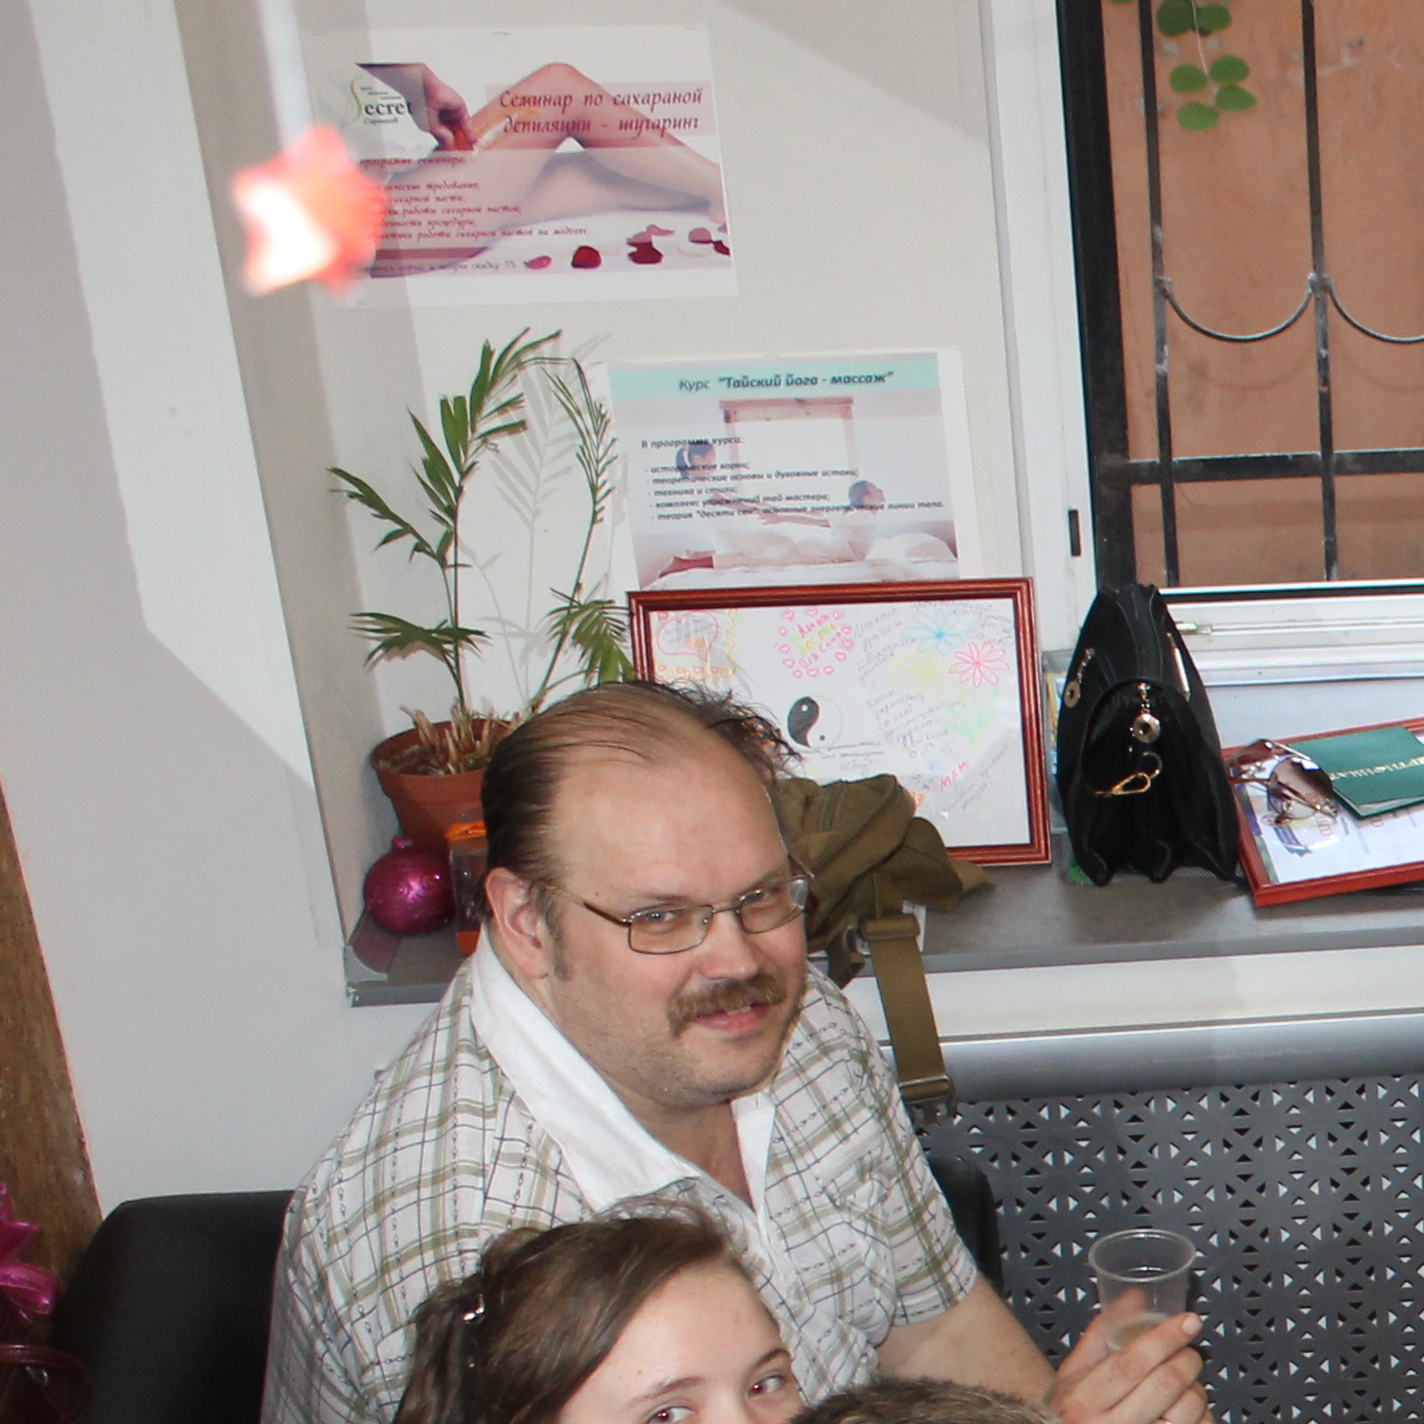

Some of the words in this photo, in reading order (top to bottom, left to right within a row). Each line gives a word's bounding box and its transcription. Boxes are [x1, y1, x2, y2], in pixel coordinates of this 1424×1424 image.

[499, 90, 573, 114] Семинар
[584, 95, 604, 107] по
[612, 88, 704, 113] сахараной
[504, 116, 592, 134] депиляции
[618, 117, 700, 137] шугаринг
[679, 378, 711, 392] Курс
[786, 373, 819, 387] йога
